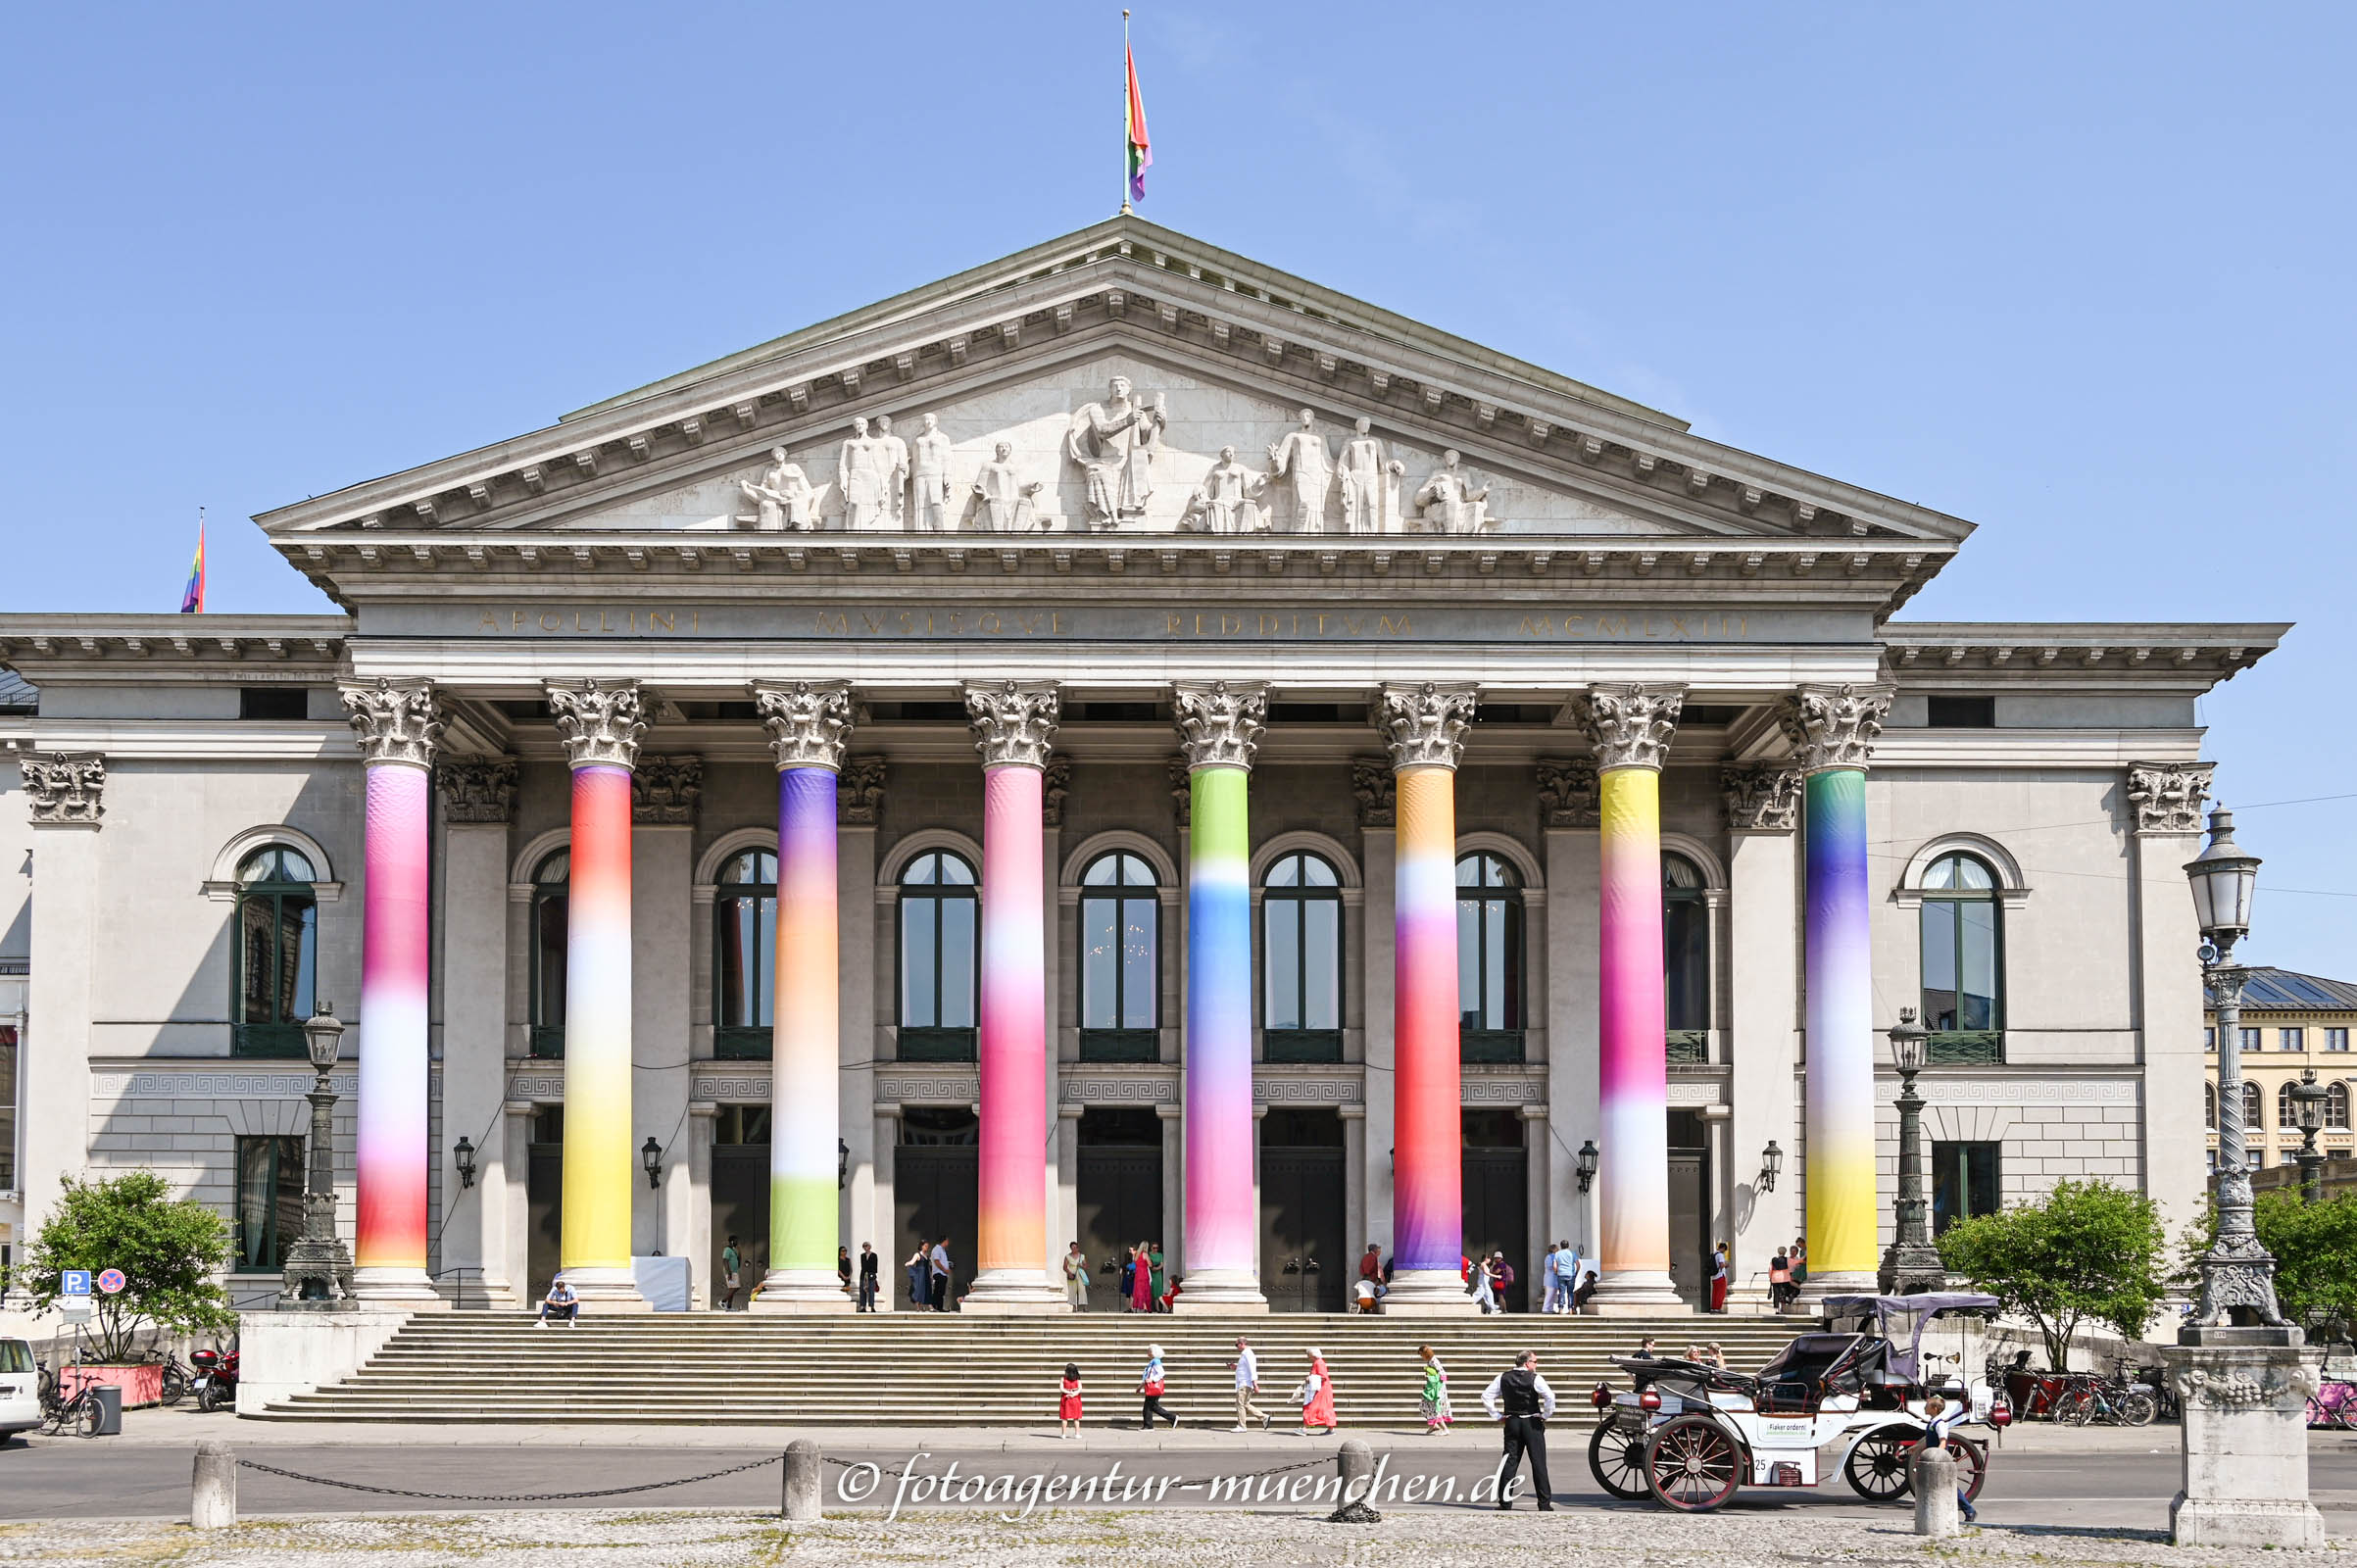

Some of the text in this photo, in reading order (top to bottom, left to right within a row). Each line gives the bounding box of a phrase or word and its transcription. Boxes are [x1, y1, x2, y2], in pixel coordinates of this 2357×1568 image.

[477, 610, 1747, 637] APOLLINI MVSISQVE REDDITVM MCMLXIII
[67, 1273, 82, 1292] P
[1755, 1459, 1766, 1471] 25
